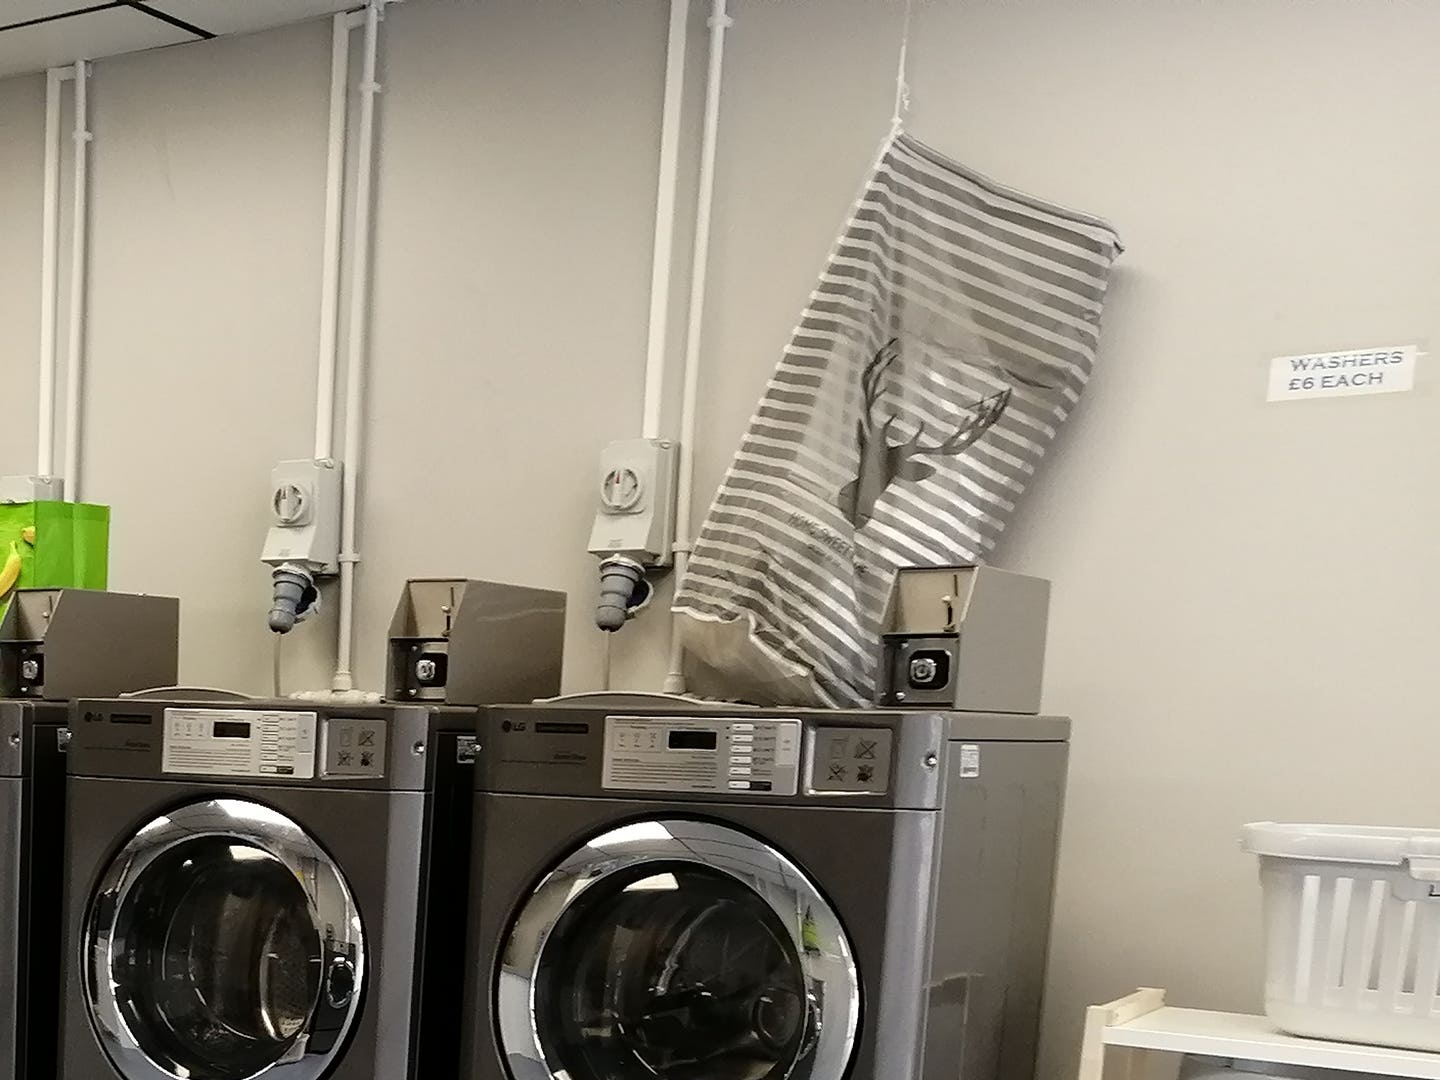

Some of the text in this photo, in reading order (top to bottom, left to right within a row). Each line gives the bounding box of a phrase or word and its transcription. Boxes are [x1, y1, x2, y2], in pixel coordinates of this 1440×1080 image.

[1290, 351, 1405, 371] WASHERS
[1288, 372, 1384, 391] £6 EACH
